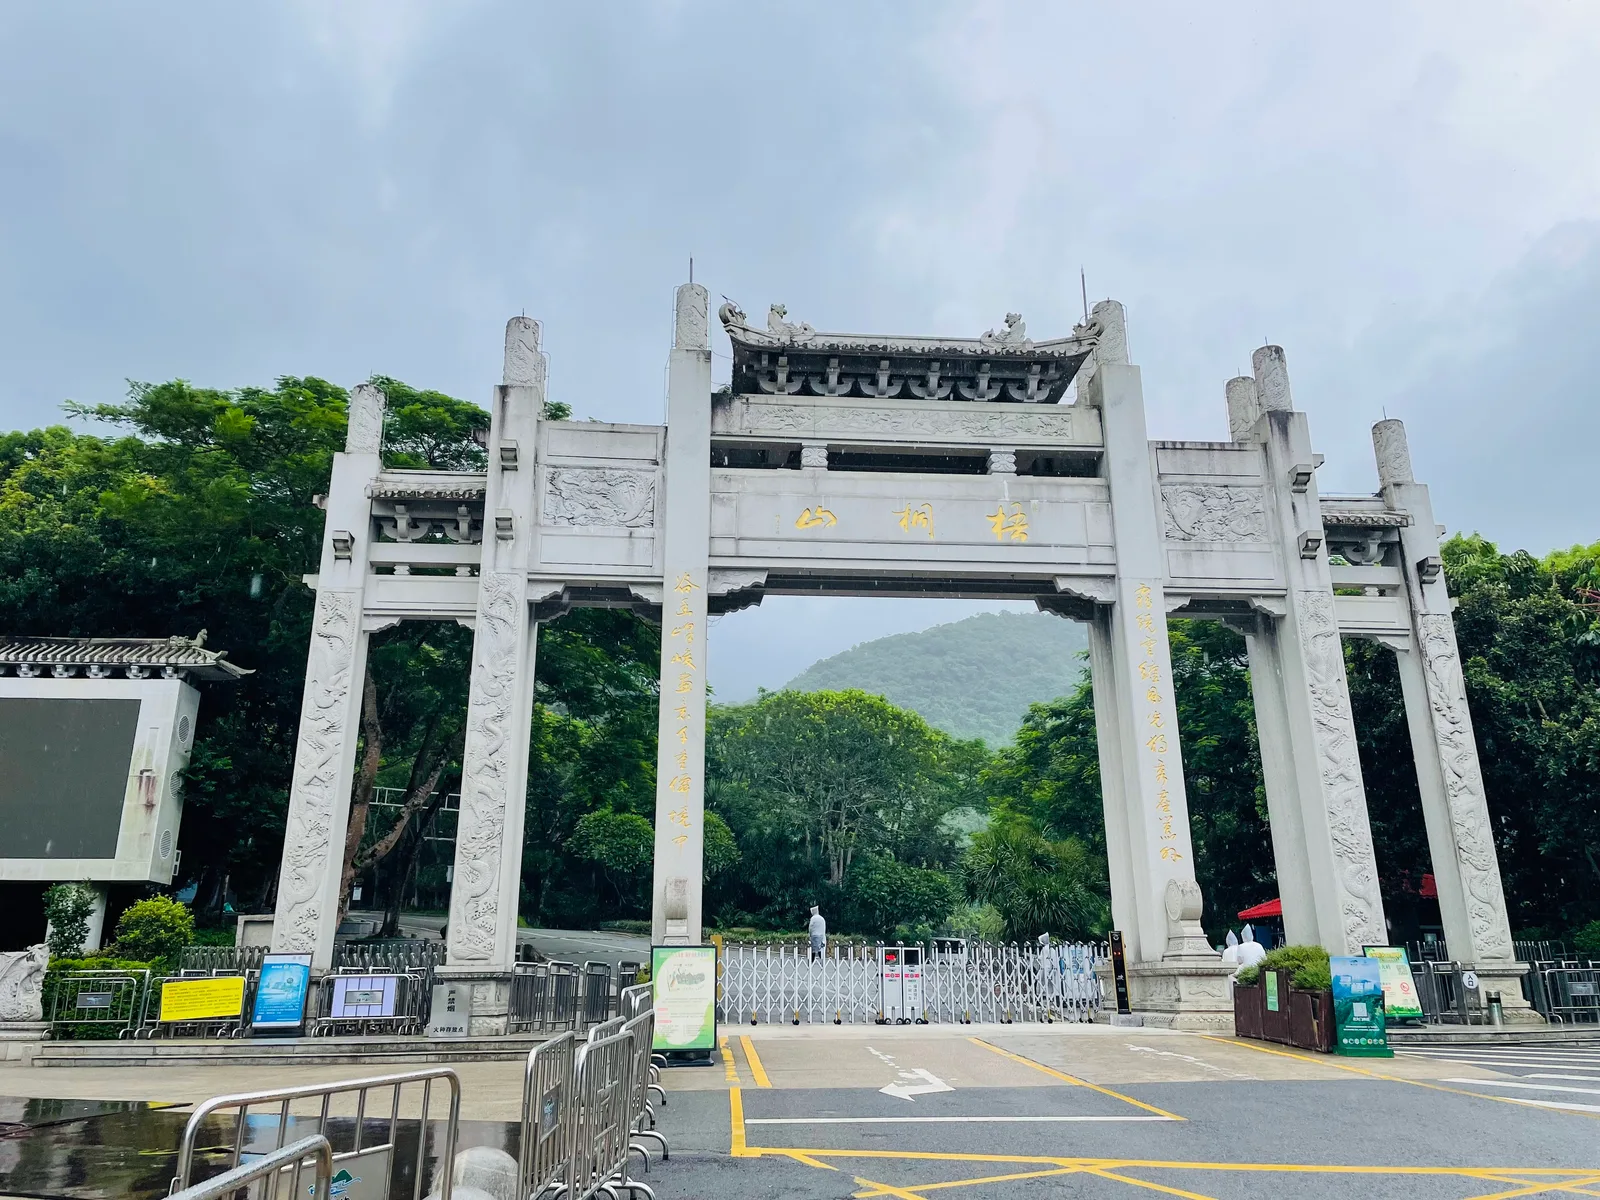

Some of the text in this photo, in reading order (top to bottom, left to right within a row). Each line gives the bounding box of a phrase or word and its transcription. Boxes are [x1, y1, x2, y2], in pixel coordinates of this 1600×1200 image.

[795, 502, 1029, 541] 梧桐山
[1467, 974, 1474, 987] 入口
